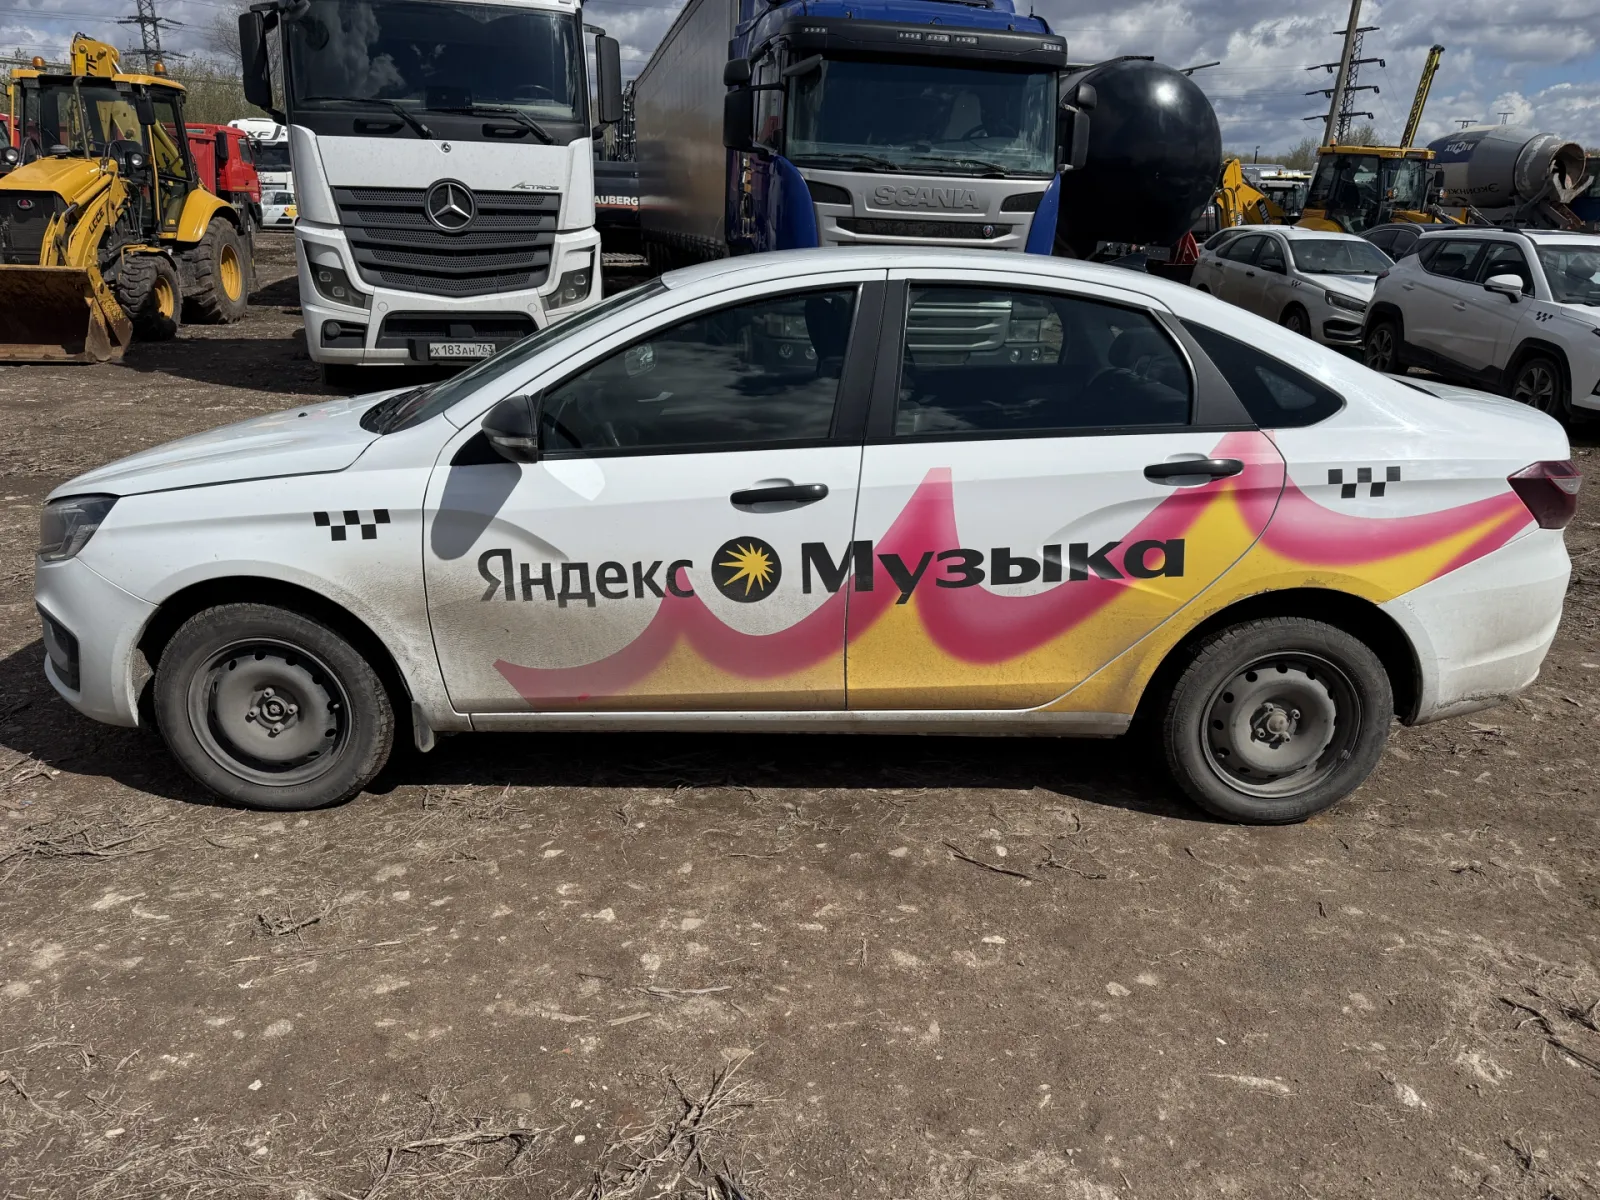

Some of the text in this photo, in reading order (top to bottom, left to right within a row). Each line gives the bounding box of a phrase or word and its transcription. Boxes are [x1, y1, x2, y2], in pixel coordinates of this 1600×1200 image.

[874, 185, 980, 210] SCANIA
[477, 538, 1185, 608] Яндекс Музыка
